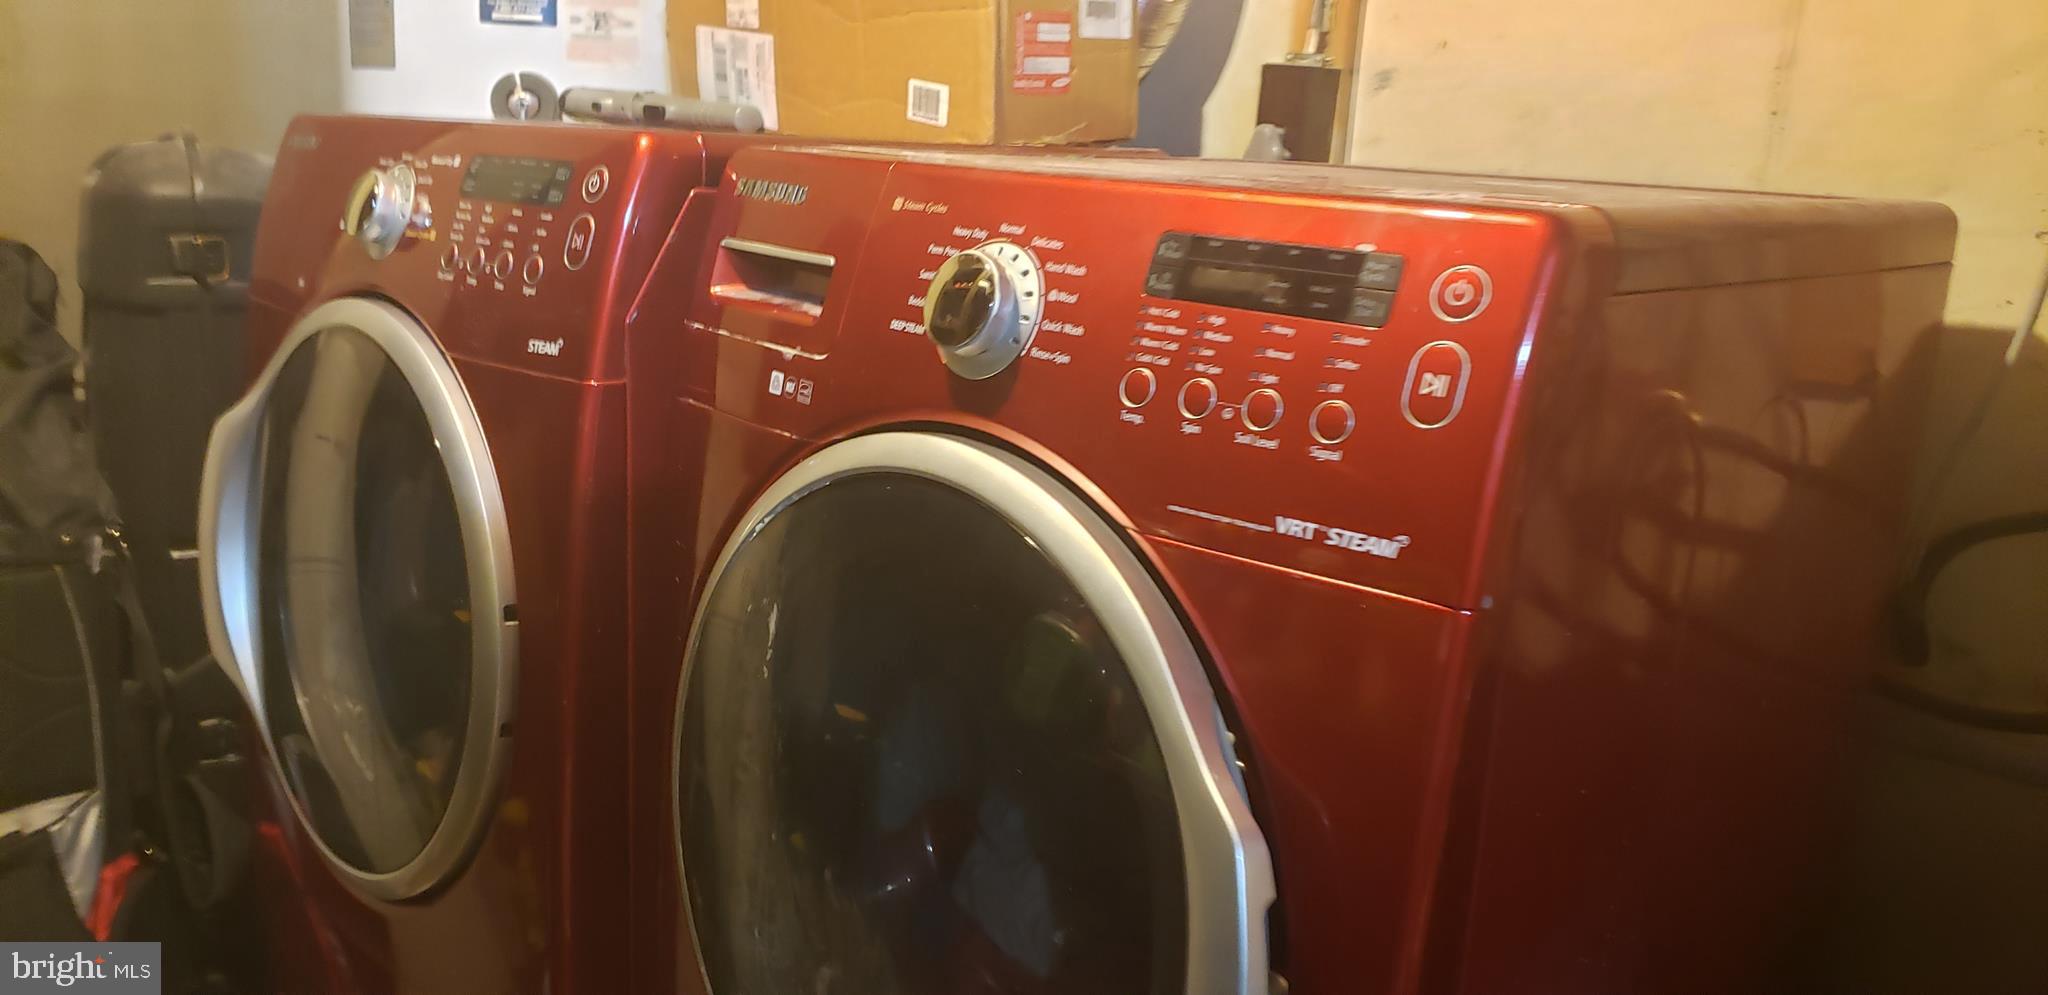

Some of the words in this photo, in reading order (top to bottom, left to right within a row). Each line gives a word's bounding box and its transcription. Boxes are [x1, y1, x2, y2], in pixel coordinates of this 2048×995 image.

[734, 176, 809, 206] SAMSUNG
[952, 224, 973, 240] Heavy
[999, 222, 1027, 236] Normal
[527, 338, 560, 357] STEAM
[1275, 515, 1320, 541] VRT
[1323, 527, 1400, 560] STEAM
